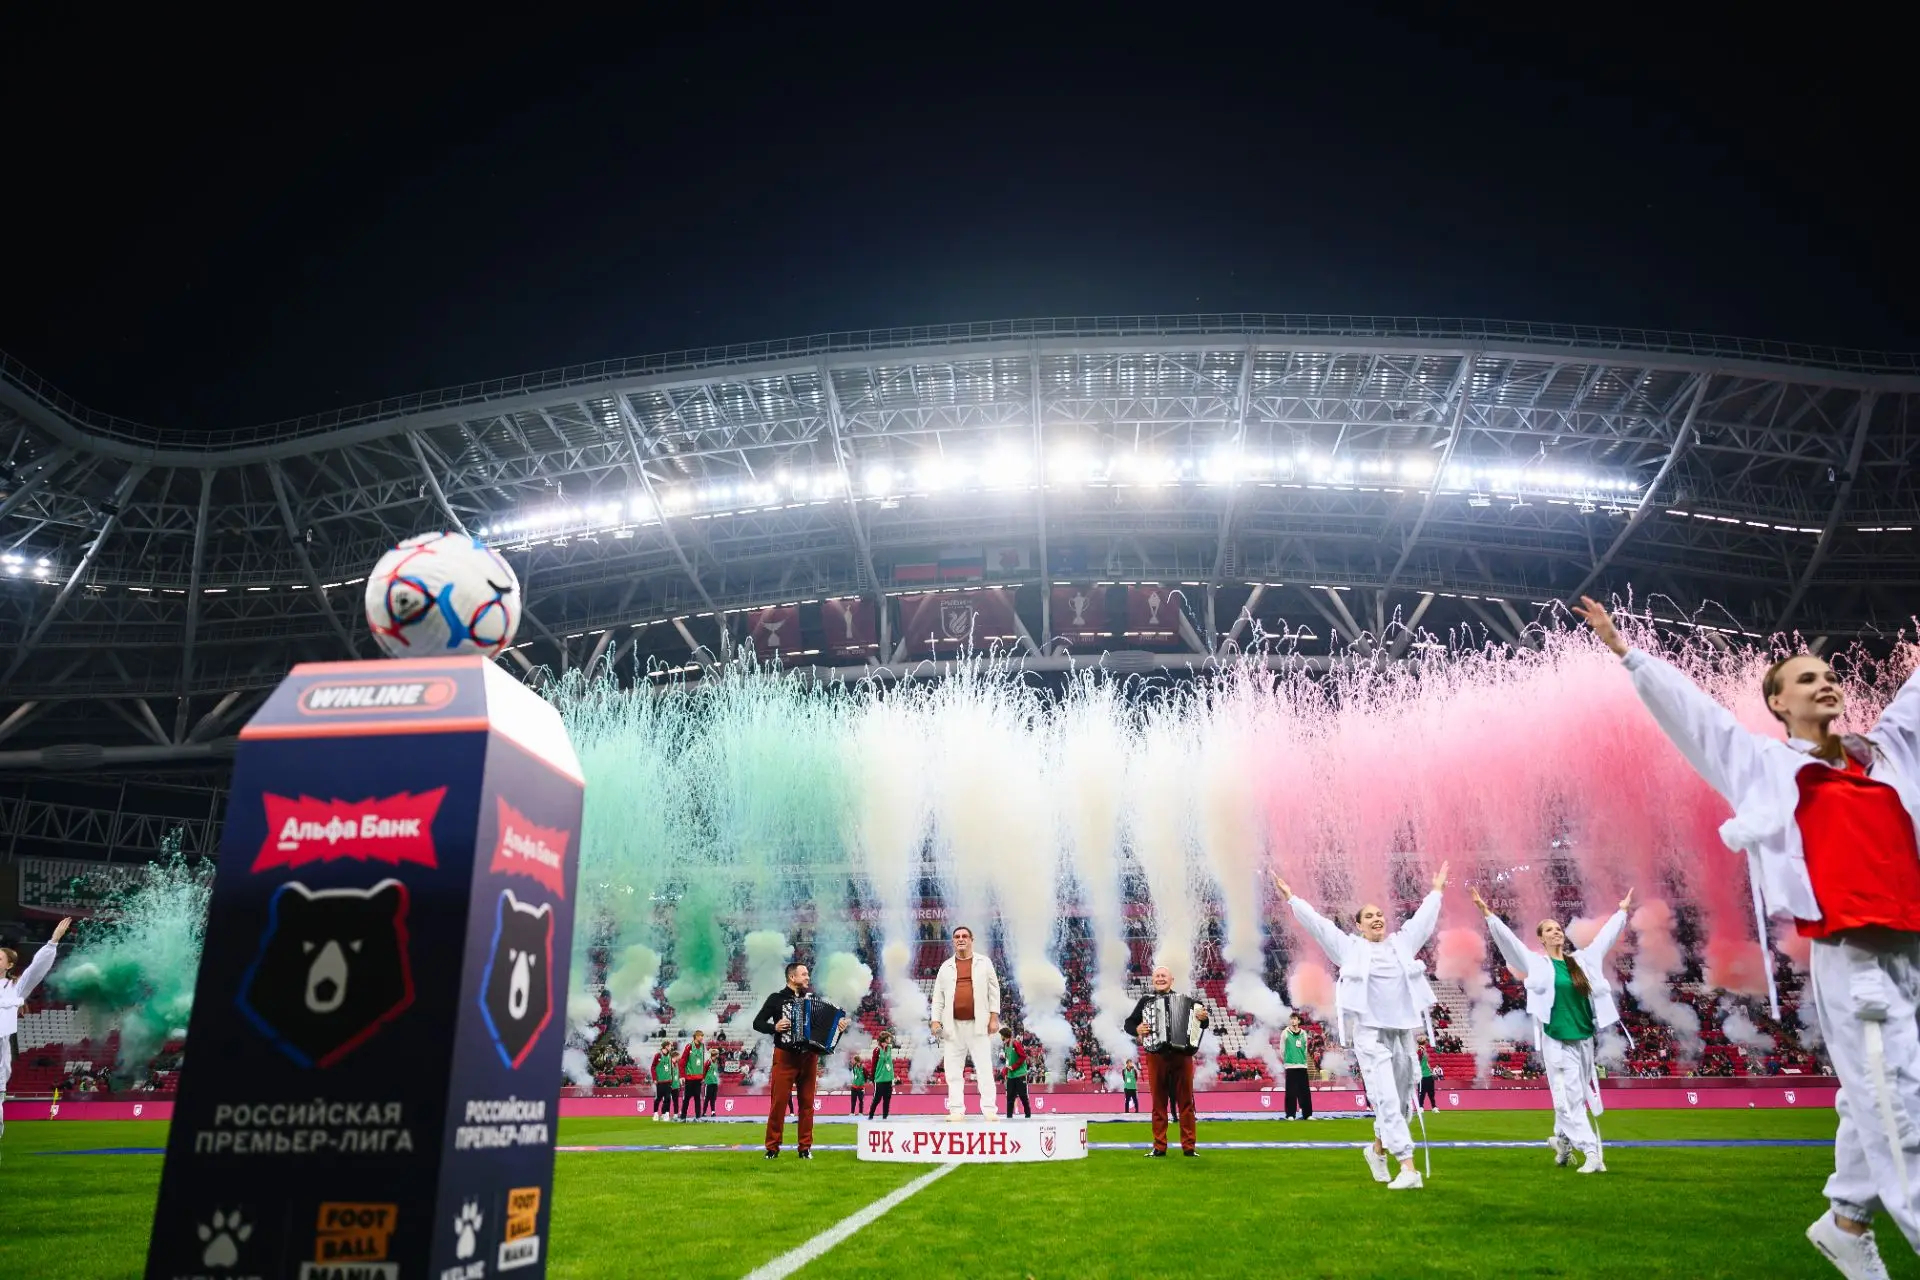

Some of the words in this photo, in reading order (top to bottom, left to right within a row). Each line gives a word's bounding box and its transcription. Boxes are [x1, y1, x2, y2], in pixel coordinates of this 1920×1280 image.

[308, 684, 424, 709] WINLINE
[278, 815, 358, 847] Альфа
[360, 814, 421, 839] Банк
[910, 908, 949, 920] ARENA
[215, 1098, 401, 1126] РОССИЙСКАЯ
[465, 1095, 546, 1122] РОССИЙСКАЯ
[195, 1129, 414, 1153] ПРЕМЬЕР-ЛИГА
[455, 1124, 549, 1149] ПРЕМЬЕР-ЛИГА
[868, 1131, 894, 1153] ФК
[901, 1131, 1022, 1155] «РУБИН»
[326, 1208, 389, 1229] FOOT
[323, 1237, 378, 1259] BALL
